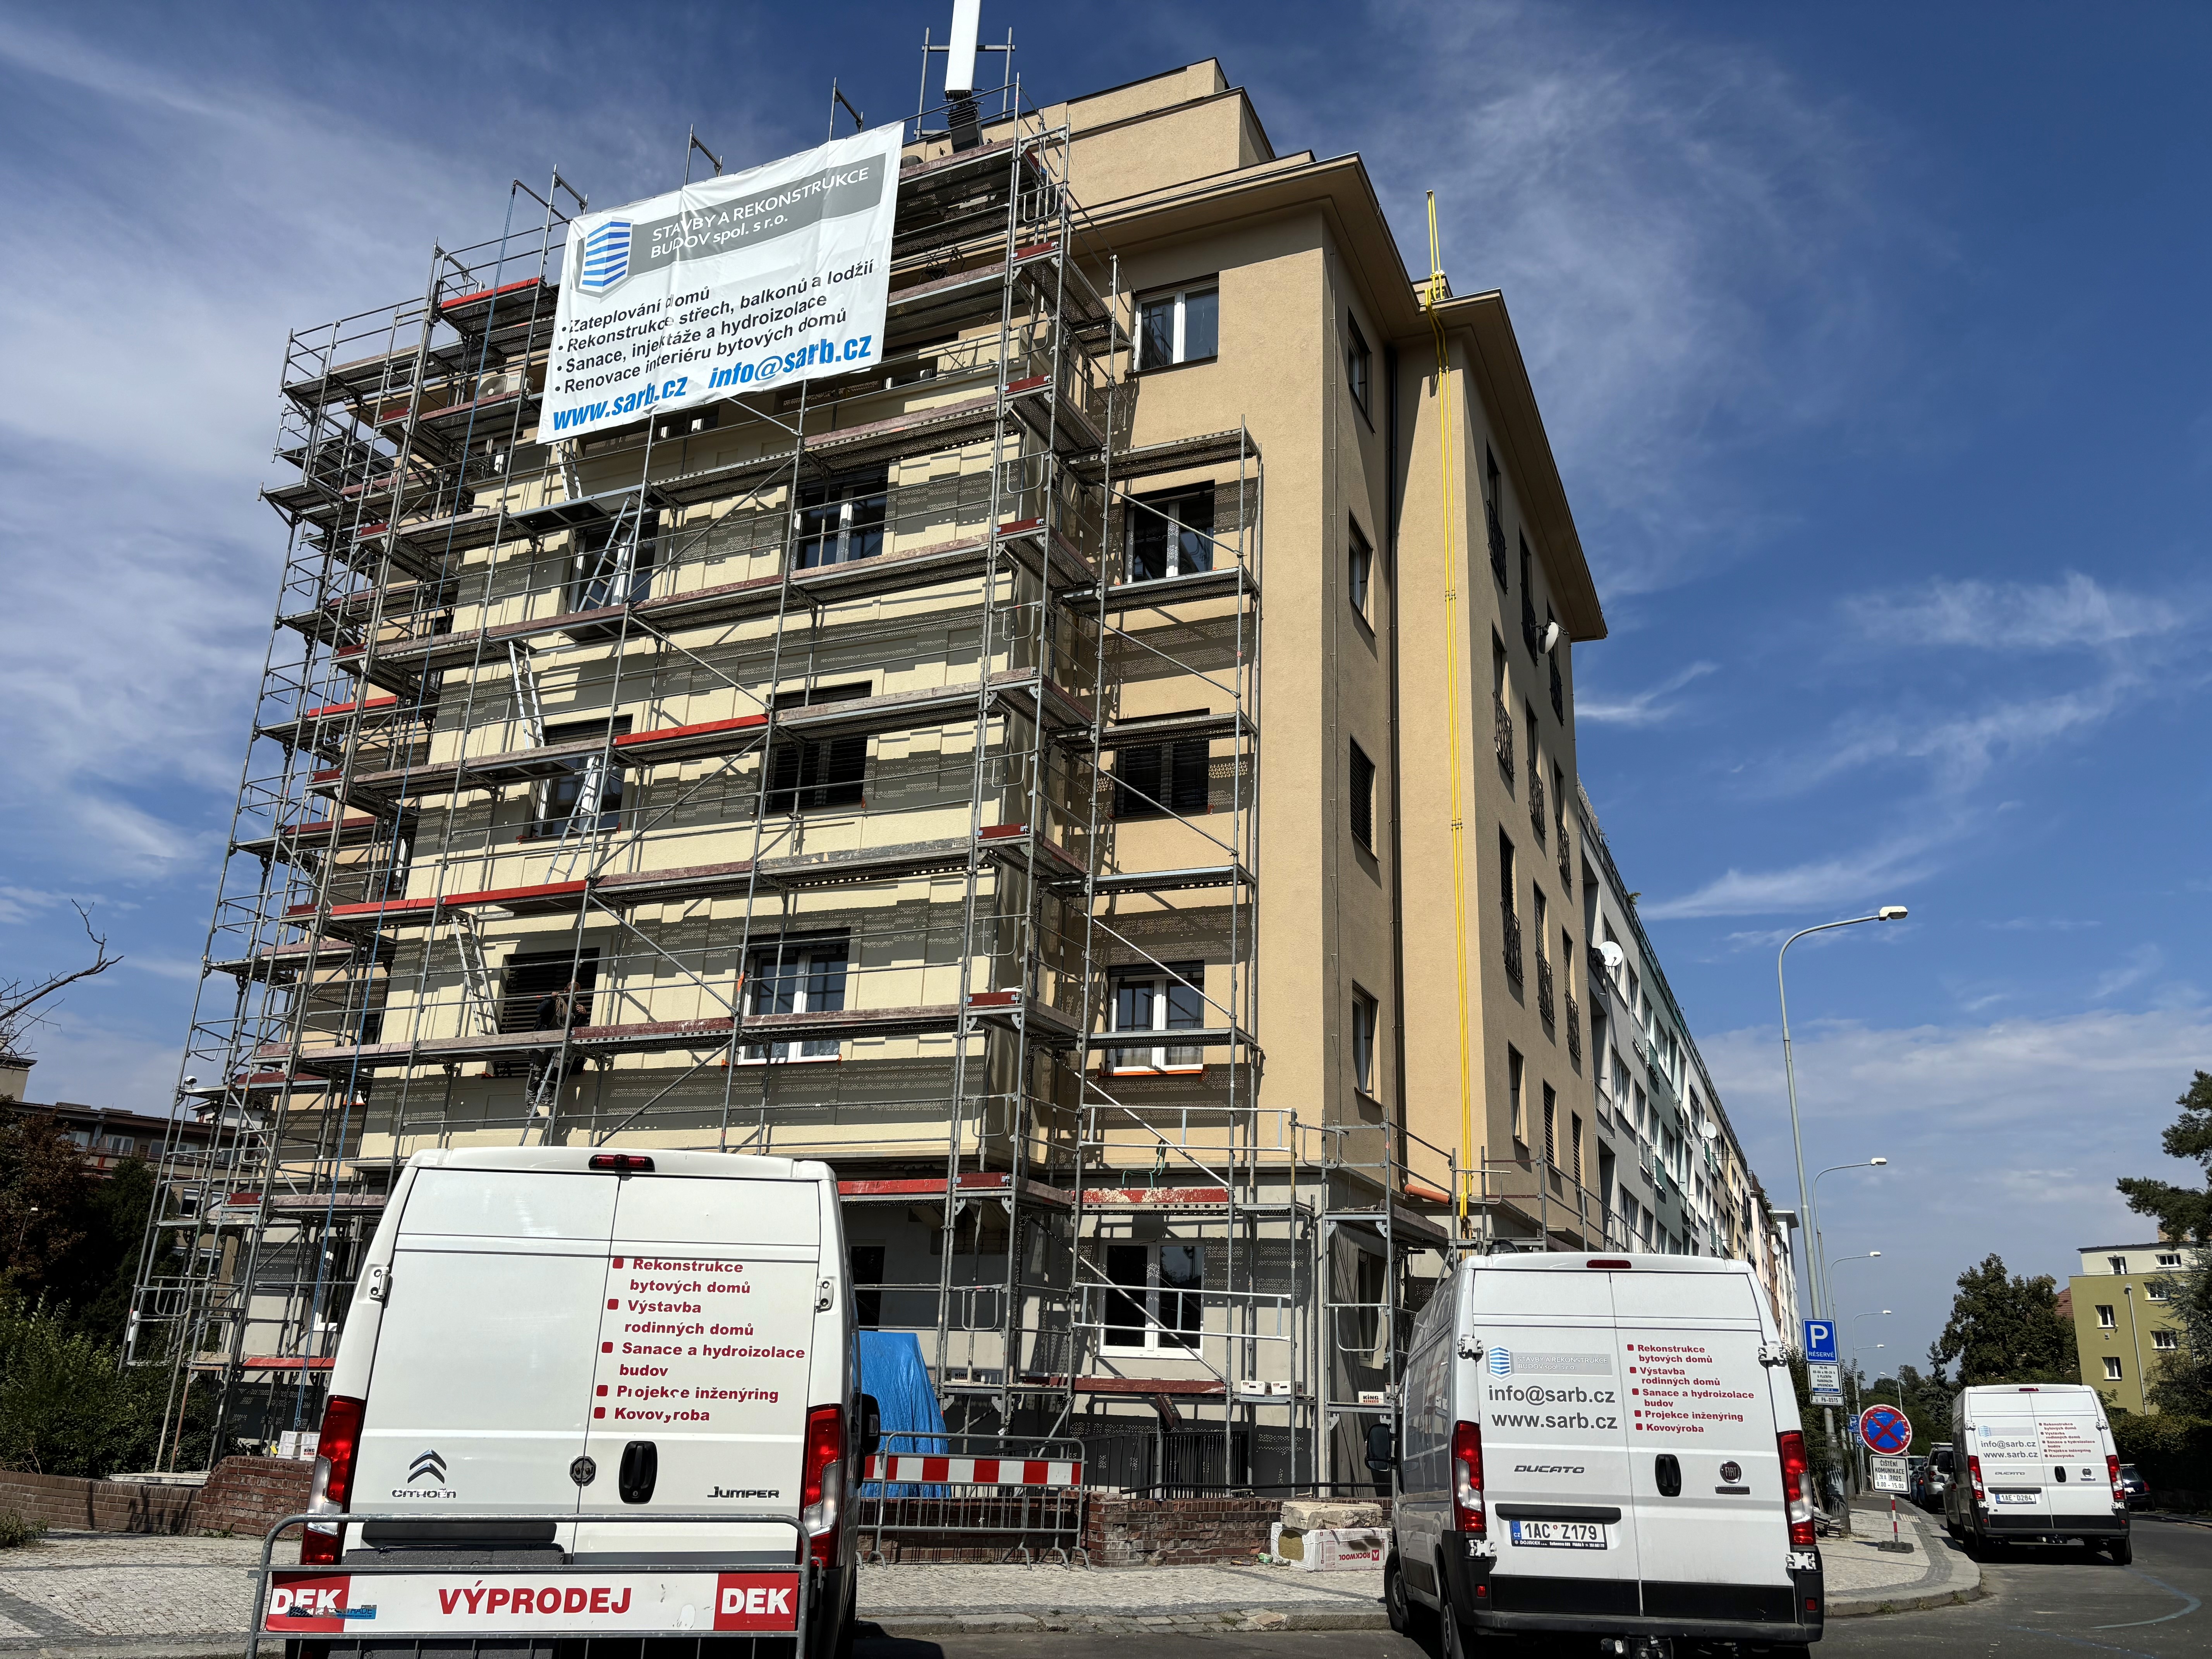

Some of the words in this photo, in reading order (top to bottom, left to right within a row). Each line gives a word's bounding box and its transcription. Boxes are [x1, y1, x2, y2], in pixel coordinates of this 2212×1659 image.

[652, 214, 717, 242] STAVBY
[718, 214, 729, 225] A
[733, 167, 869, 221] REKONSTRUKCE
[651, 232, 711, 258] BUDOV
[713, 227, 749, 245] spol.
[753, 222, 759, 233] s
[764, 214, 788, 230] r.o.
[567, 316, 674, 352] Rekonstrukce
[679, 301, 734, 325] střech,
[740, 278, 807, 309] balkonů
[812, 276, 821, 288] a
[828, 258, 874, 285] lodžií
[569, 299, 662, 333] Zateplování
[665, 286, 710, 309] domů
[566, 350, 626, 373] Sanace,
[632, 329, 701, 359] injektáže
[706, 327, 715, 339] a
[721, 295, 827, 336] hydroizolace
[565, 366, 640, 393] Renovace
[645, 348, 711, 373] interiéru
[717, 325, 793, 357] bytových
[799, 307, 846, 333] domů
[553, 376, 688, 430] www.sarb.cz
[708, 335, 872, 388] info@sarb.cz
[633, 1259, 743, 1273] Rekonstrukce
[630, 1279, 701, 1294] bytových
[707, 1281, 750, 1293] domů
[628, 1300, 701, 1314] Výstavba
[624, 1321, 704, 1337] rodinných
[710, 1323, 754, 1336] domů
[1810, 1325, 1828, 1348] P
[622, 1342, 682, 1355] Sanace
[687, 1345, 697, 1355] a
[702, 1344, 805, 1359] hydroizolace
[1637, 1345, 1705, 1353] Rekonstrukce
[1639, 1355, 1683, 1364] bytových
[1686, 1355, 1712, 1363] domů
[619, 1364, 668, 1376] budov
[1640, 1367, 1685, 1376] Výstavba
[1642, 1377, 1690, 1386] rodinných
[1693, 1377, 1720, 1386] domů
[695, 1387, 779, 1403] inženýring
[1489, 1385, 1615, 1406] info@sarb.cz
[1643, 1388, 1679, 1396] Sanace
[1691, 1390, 1754, 1399] hydroizolace
[1491, 1412, 1618, 1429] www.sarb.cz
[1645, 1410, 1689, 1420] Projekce
[1692, 1411, 1743, 1422] inženýring
[1646, 1424, 1704, 1433] Kovovýroba
[1981, 1440, 2036, 1449] info@sarb.cz
[1514, 1465, 1585, 1474] DUCATO
[1725, 1467, 1737, 1477] FIAT
[1525, 1523, 1551, 1539] 1AC
[1561, 1524, 1597, 1540] Z179
[1339, 1553, 1370, 1561] ROCKWOOL
[269, 1588, 342, 1615] DEK
[438, 1579, 631, 1615] VÝPRODEJ
[721, 1587, 792, 1615] DEK
